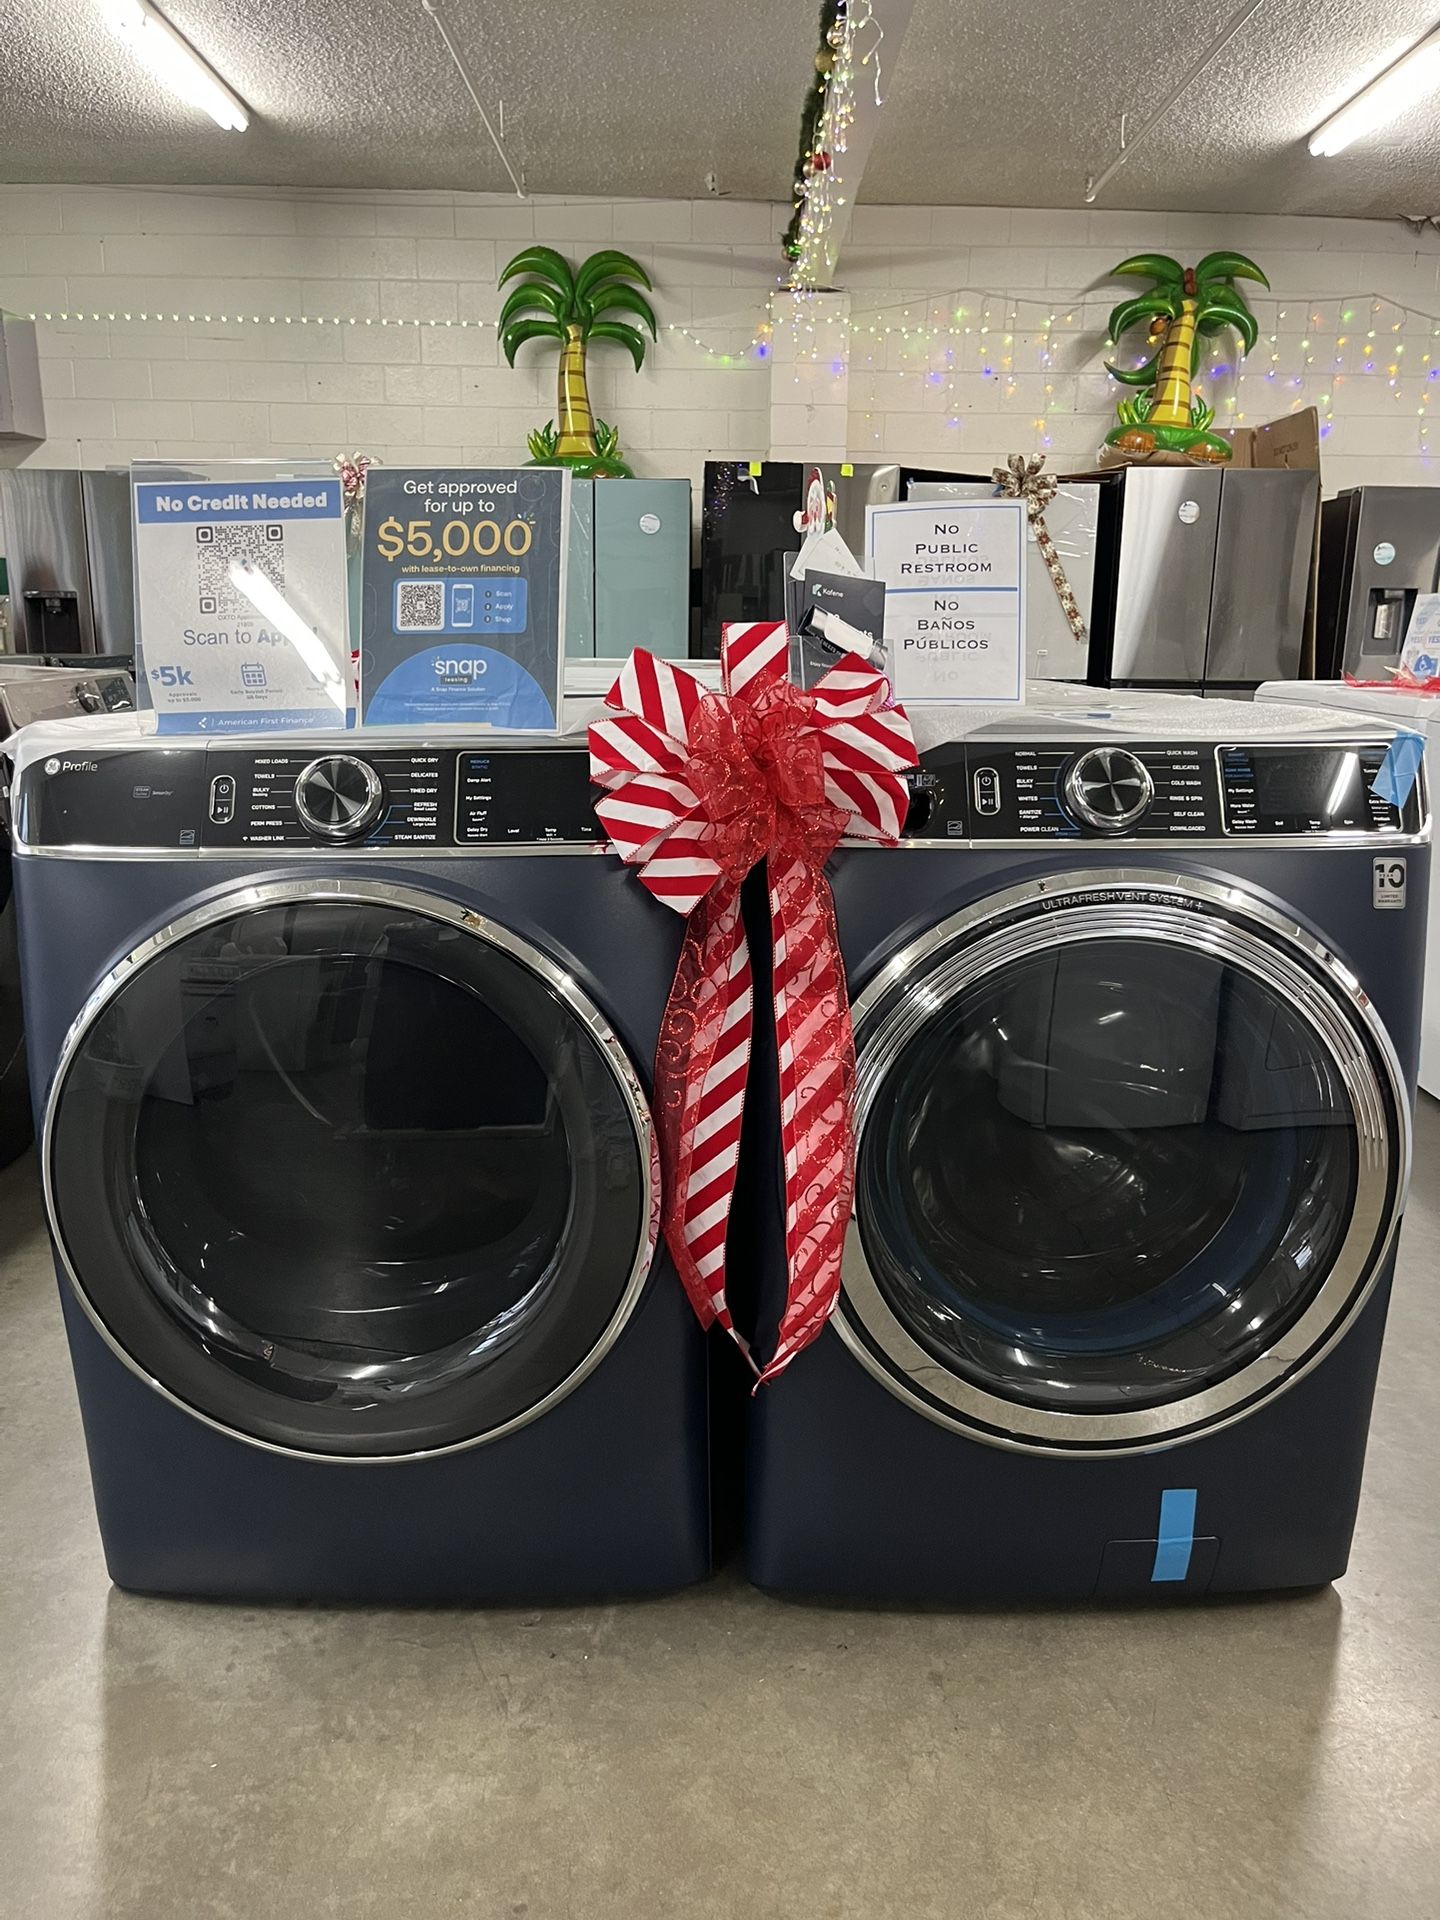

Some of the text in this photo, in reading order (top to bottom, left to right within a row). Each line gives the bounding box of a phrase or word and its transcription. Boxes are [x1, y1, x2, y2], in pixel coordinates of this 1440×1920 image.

[403, 480, 517, 496] Get approved
[156, 492, 327, 512] No Credit Needed
[424, 499, 495, 515] for up to
[377, 516, 532, 562] $5,000
[402, 564, 520, 574] with lease-to-own financing
[822, 588, 844, 598] Kafene
[495, 603, 513, 611] Apply
[495, 615, 512, 623] Shop
[183, 629, 229, 645] Scan
[235, 629, 251, 644] to
[151, 666, 194, 686] $5k
[435, 659, 487, 680] snap
[218, 718, 258, 726] American
[62, 761, 98, 771] Profile
[1375, 864, 1405, 888] 10
[1041, 891, 1203, 911] ULTRAFRESH VENT SYSTEM +
